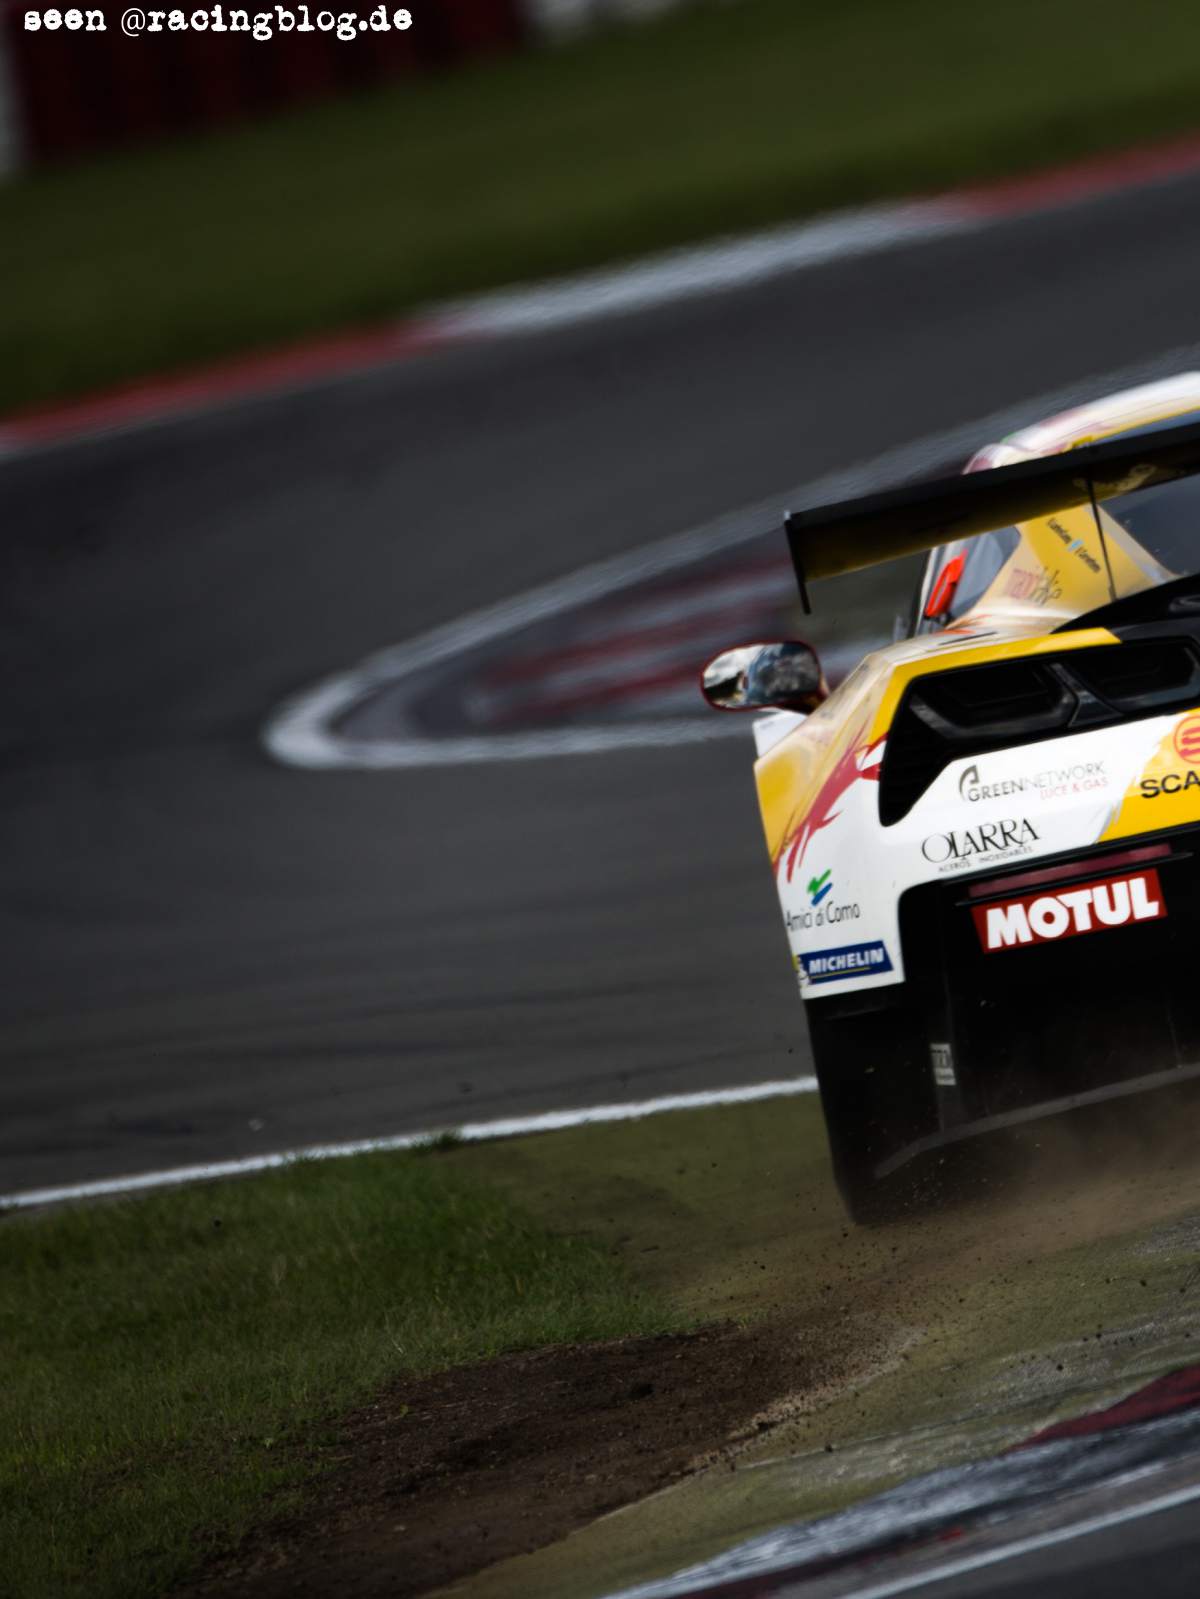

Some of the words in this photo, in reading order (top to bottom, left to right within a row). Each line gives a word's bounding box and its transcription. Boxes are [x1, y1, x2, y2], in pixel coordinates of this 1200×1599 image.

[1040, 783, 1068, 799] LUCE
[1083, 777, 1109, 790] GAS
[922, 818, 1040, 863] OLARRA
[787, 907, 812, 931] Amici
[826, 901, 860, 923] Como
[986, 877, 1159, 949] MOTUL
[809, 948, 884, 974] MICHELIN
